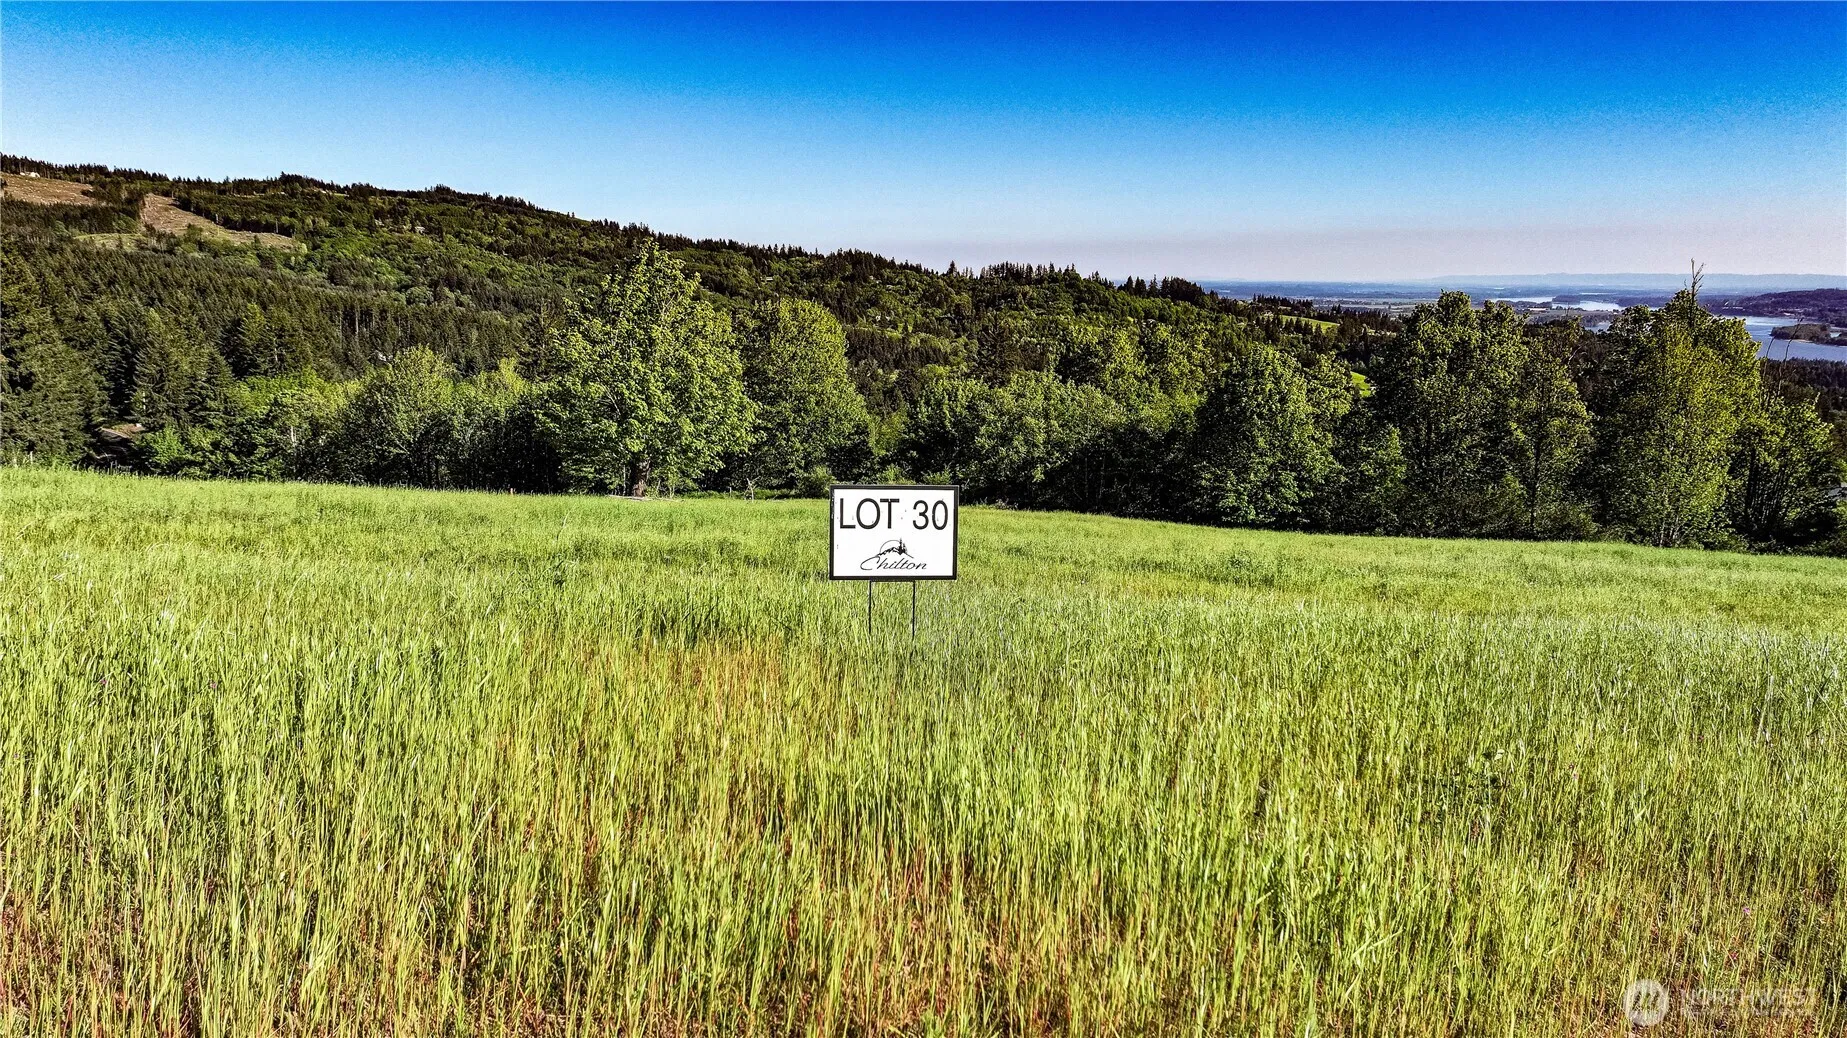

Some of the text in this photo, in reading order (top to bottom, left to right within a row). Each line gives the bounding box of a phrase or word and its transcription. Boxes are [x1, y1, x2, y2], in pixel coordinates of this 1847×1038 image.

[840, 498, 948, 530] LOT 30
[860, 555, 927, 571] Chilton
